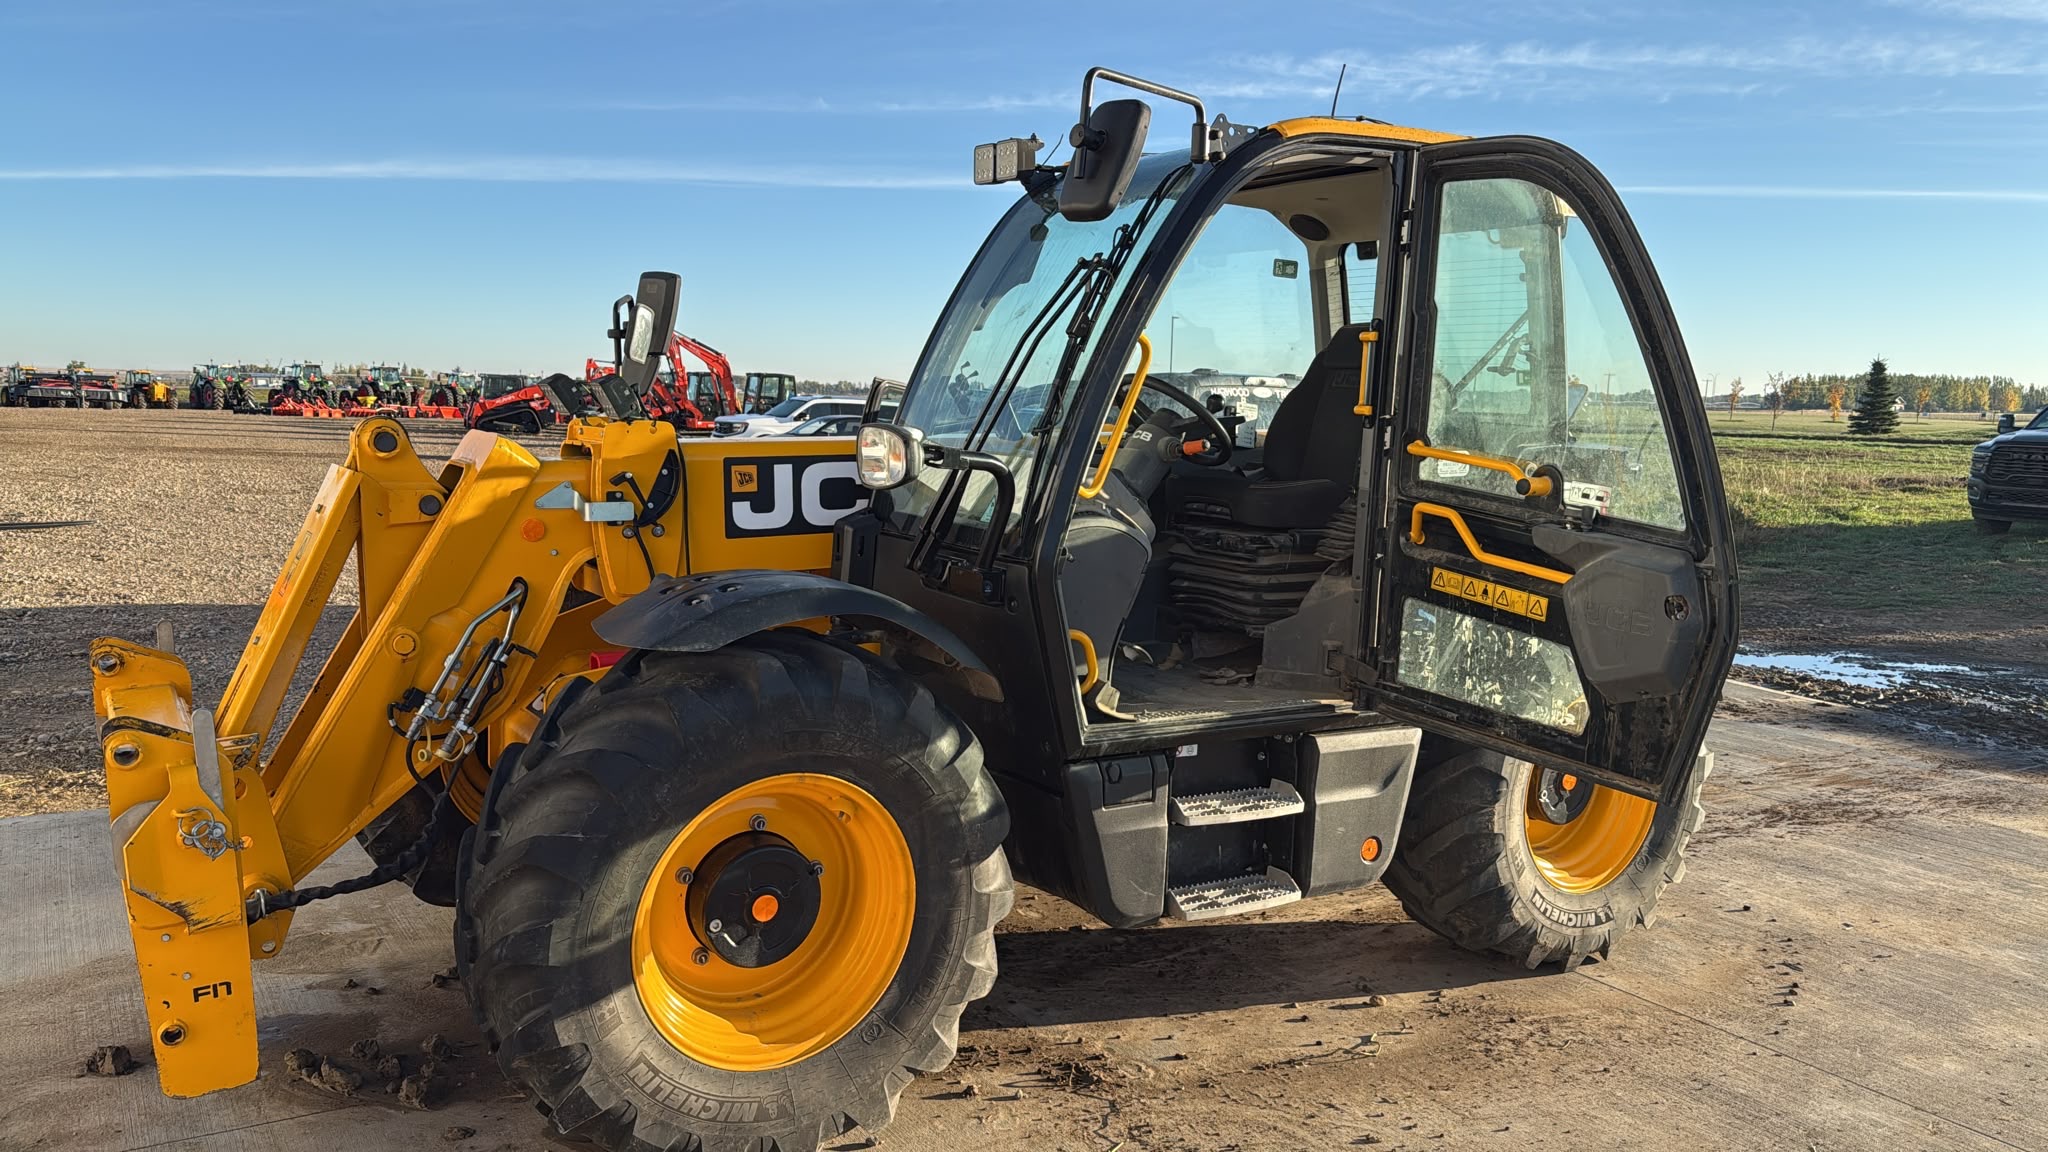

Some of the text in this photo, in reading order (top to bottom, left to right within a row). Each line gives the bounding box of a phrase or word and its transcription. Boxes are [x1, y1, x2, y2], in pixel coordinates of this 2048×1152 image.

[732, 461, 869, 530] JC
[737, 471, 754, 485] JCB
[1531, 893, 1596, 927] MICHELIN
[627, 1062, 760, 1122] MICHELIN
